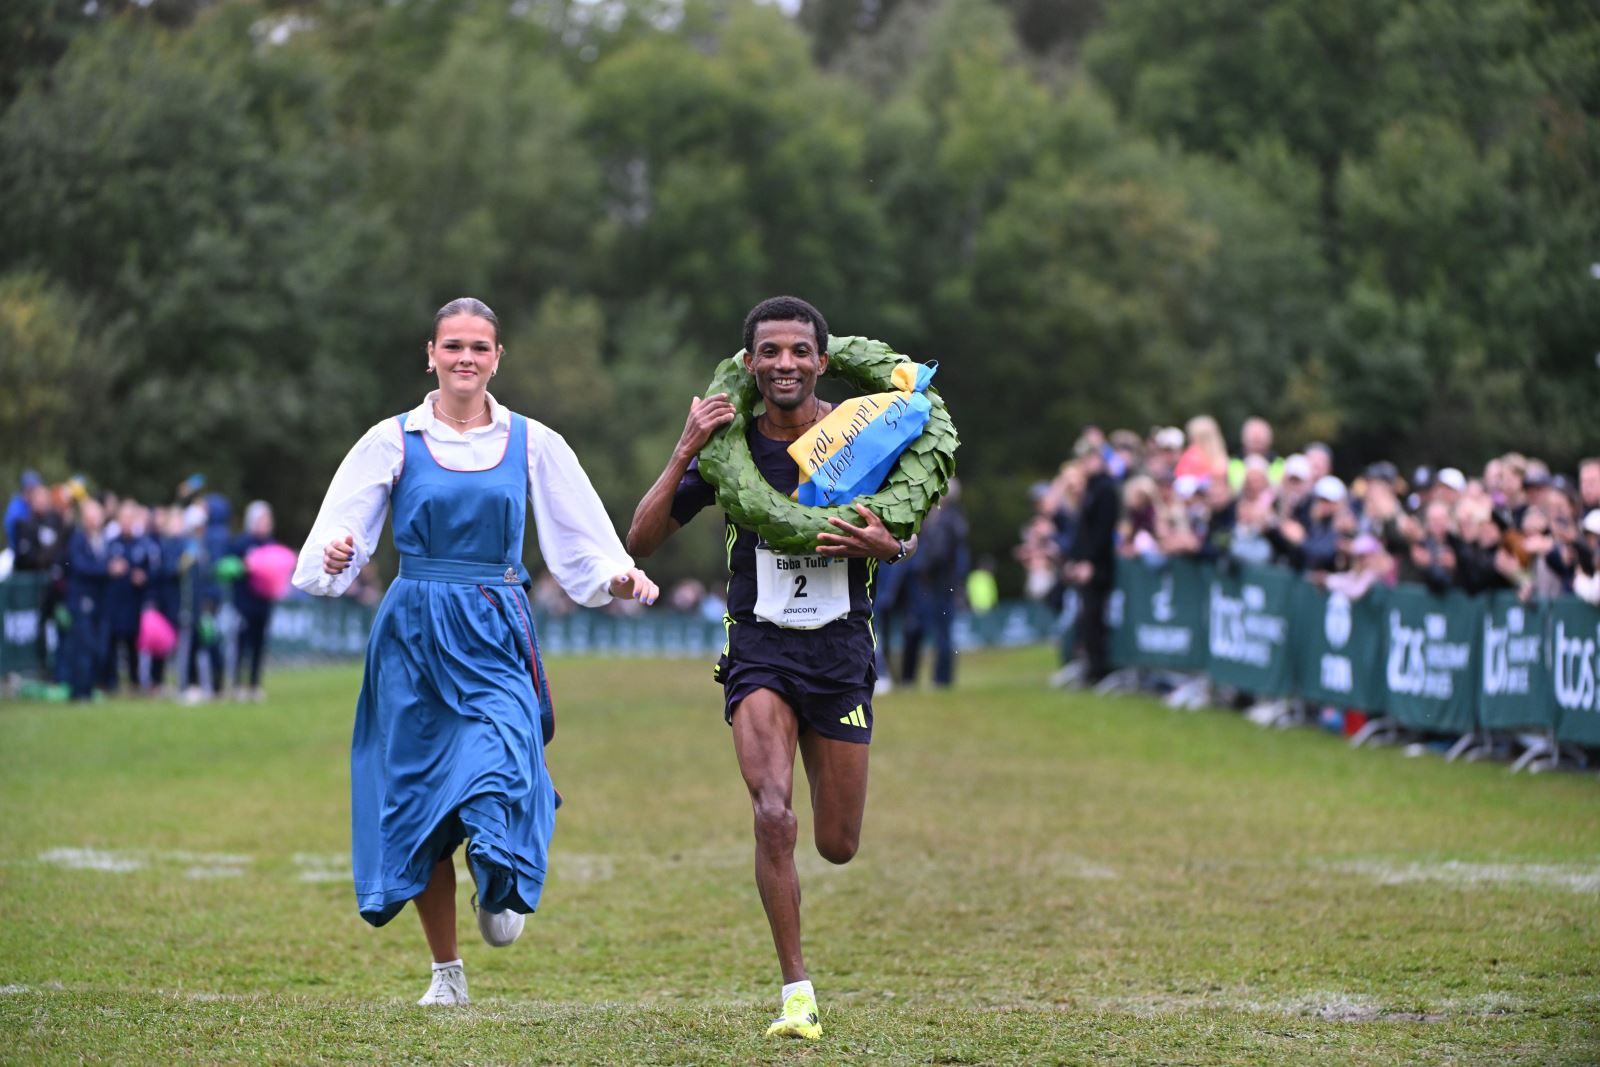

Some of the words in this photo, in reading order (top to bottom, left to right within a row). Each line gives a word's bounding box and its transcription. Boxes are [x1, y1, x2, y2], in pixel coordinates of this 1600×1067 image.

[776, 558, 801, 570] Ebba
[794, 574, 808, 598] 2
[783, 606, 818, 615] saucony
[1554, 620, 1595, 711] tcs
